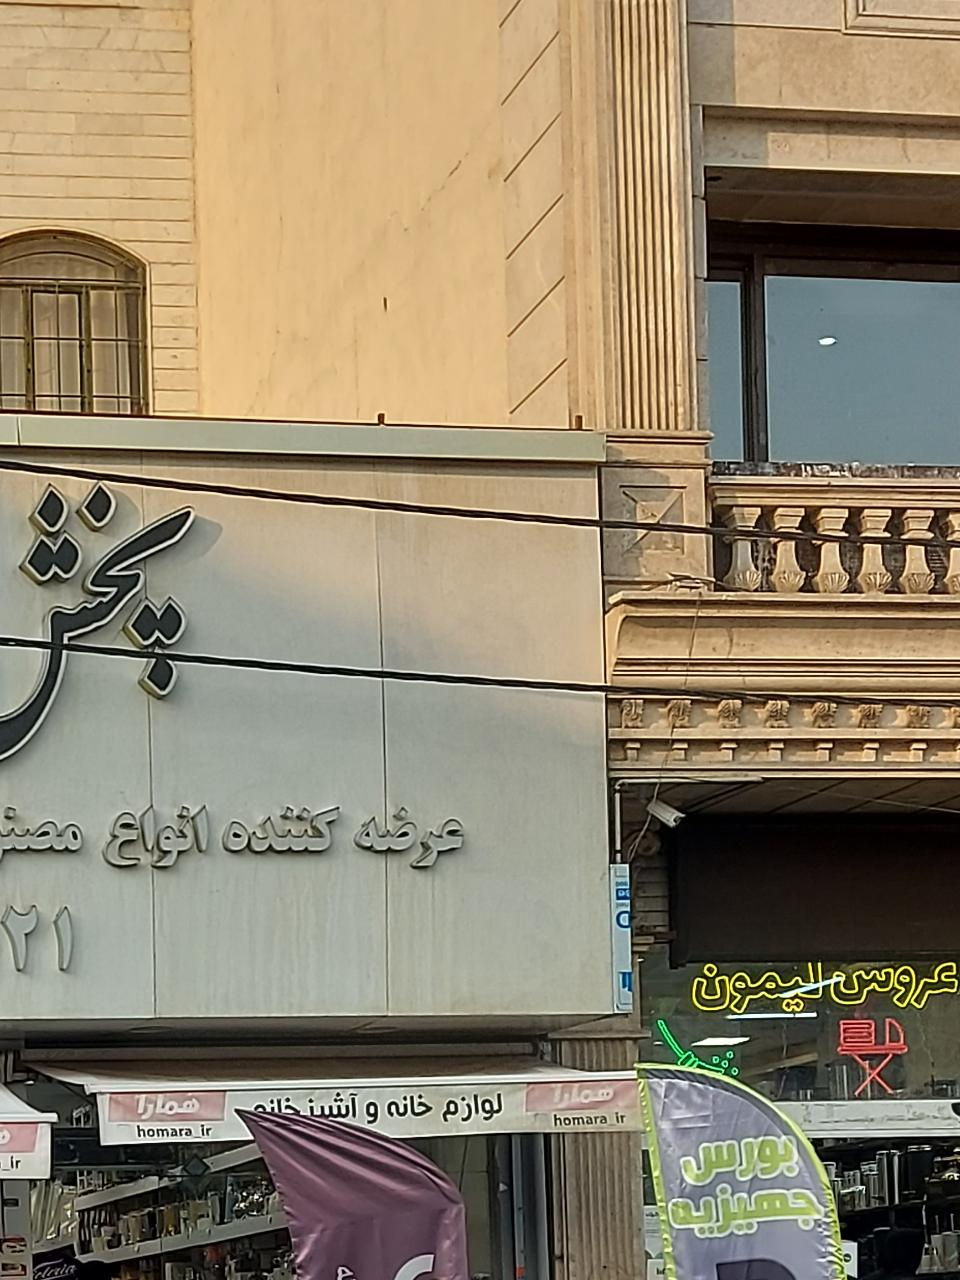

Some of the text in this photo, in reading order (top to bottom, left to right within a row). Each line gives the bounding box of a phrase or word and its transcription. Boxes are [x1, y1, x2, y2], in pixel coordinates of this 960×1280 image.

[102, 803, 211, 868] انواع
[222, 805, 341, 856] کننده
[354, 805, 465, 869] عرضه
[692, 962, 959, 1012] عروس لیمون
[135, 1092, 201, 1120] همارا
[365, 1099, 380, 1124] و
[386, 1093, 434, 1118] خانه
[441, 1092, 504, 1122] لوازم
[552, 1111, 626, 1127] homara_ir
[137, 1124, 212, 1140] homara_ir
[680, 1133, 799, 1186] بورس
[668, 1183, 824, 1239] جهیزیه
